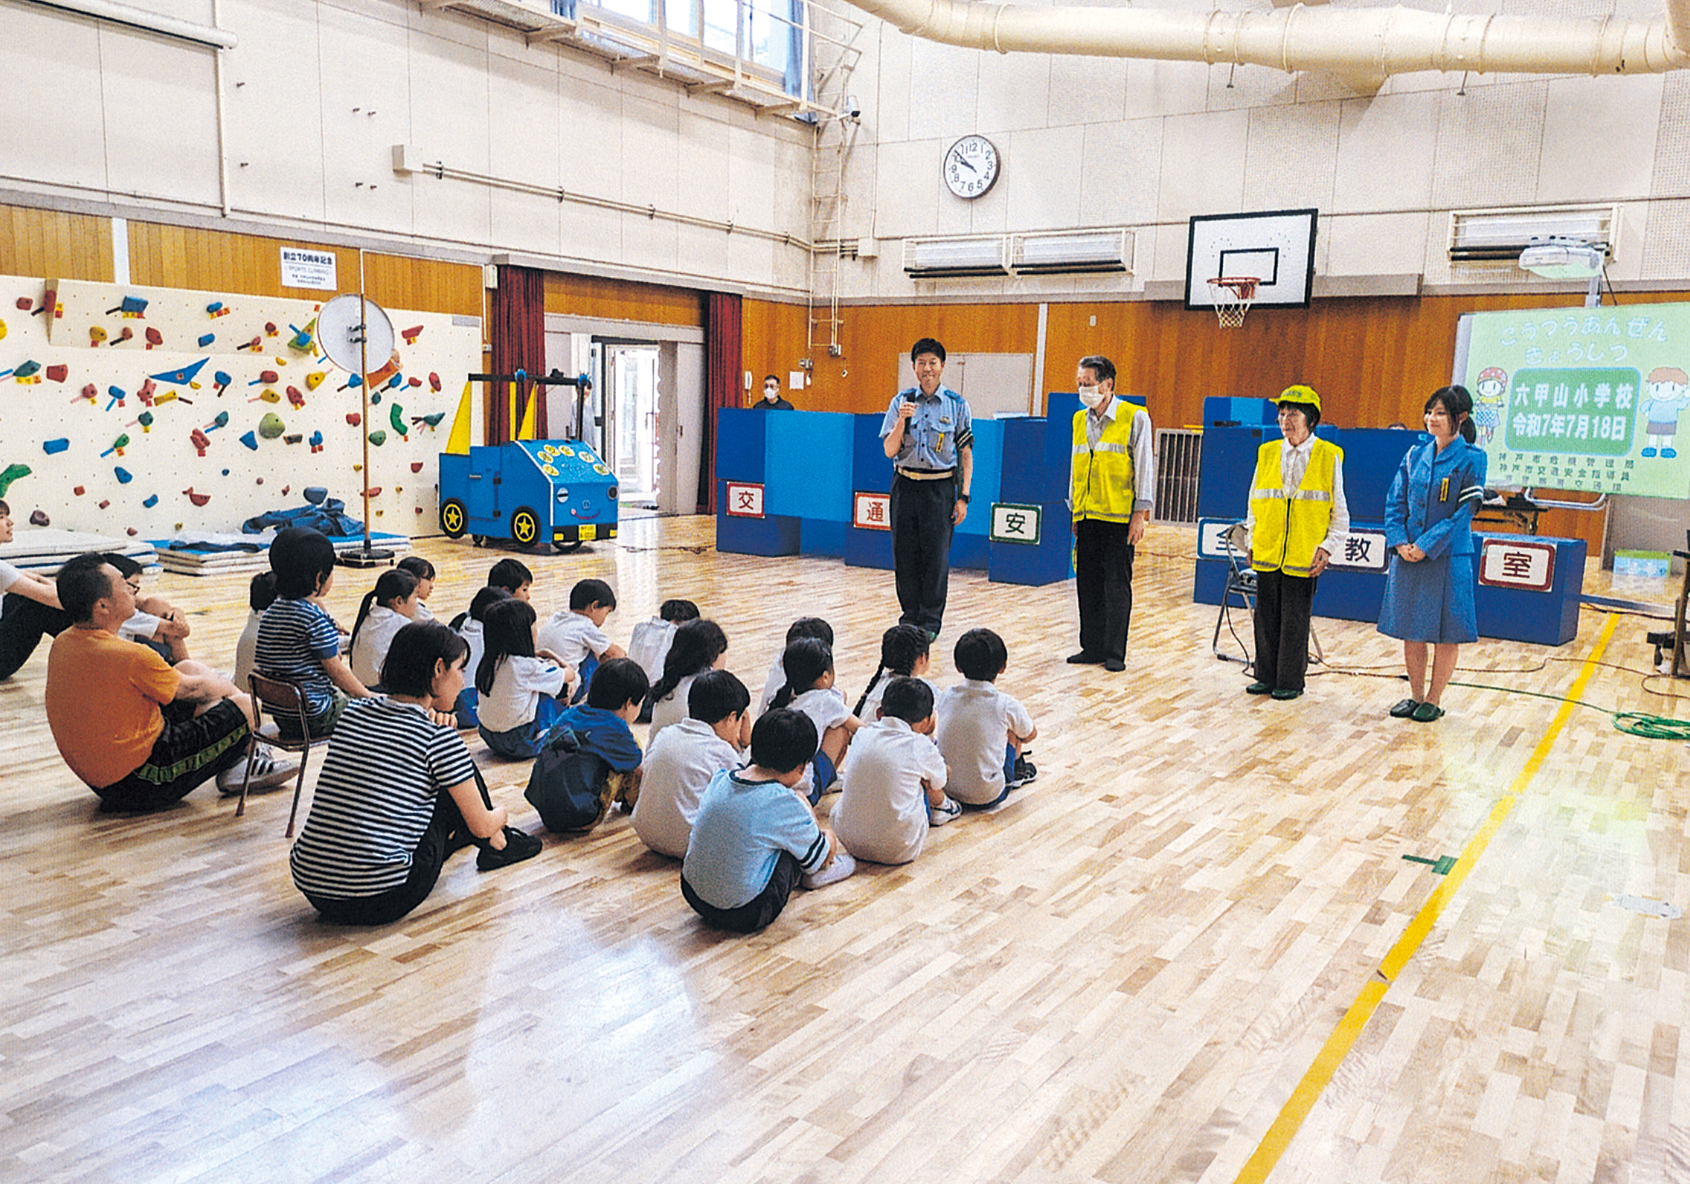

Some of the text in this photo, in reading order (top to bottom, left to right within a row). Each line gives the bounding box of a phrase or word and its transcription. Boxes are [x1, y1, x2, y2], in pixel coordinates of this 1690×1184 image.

[960, 143, 968, 155] 11
[969, 142, 978, 152] 12
[951, 164, 957, 173] 9
[987, 160, 993, 170] 3
[954, 173, 960, 182] 8
[960, 180, 966, 190] 7
[967, 182, 974, 192] 6
[976, 179, 983, 189] 5
[1500, 314, 1668, 347] こうつうあんぜん
[1525, 341, 1629, 365] きょうしつ
[1514, 382, 1635, 410] 六甲山小学校
[1512, 412, 1627, 441] 令和7年7月18日
[738, 490, 755, 511] 交
[866, 501, 884, 523] 通
[1005, 512, 1026, 535] 安
[1345, 537, 1371, 563] 教
[1502, 551, 1532, 579] 室
